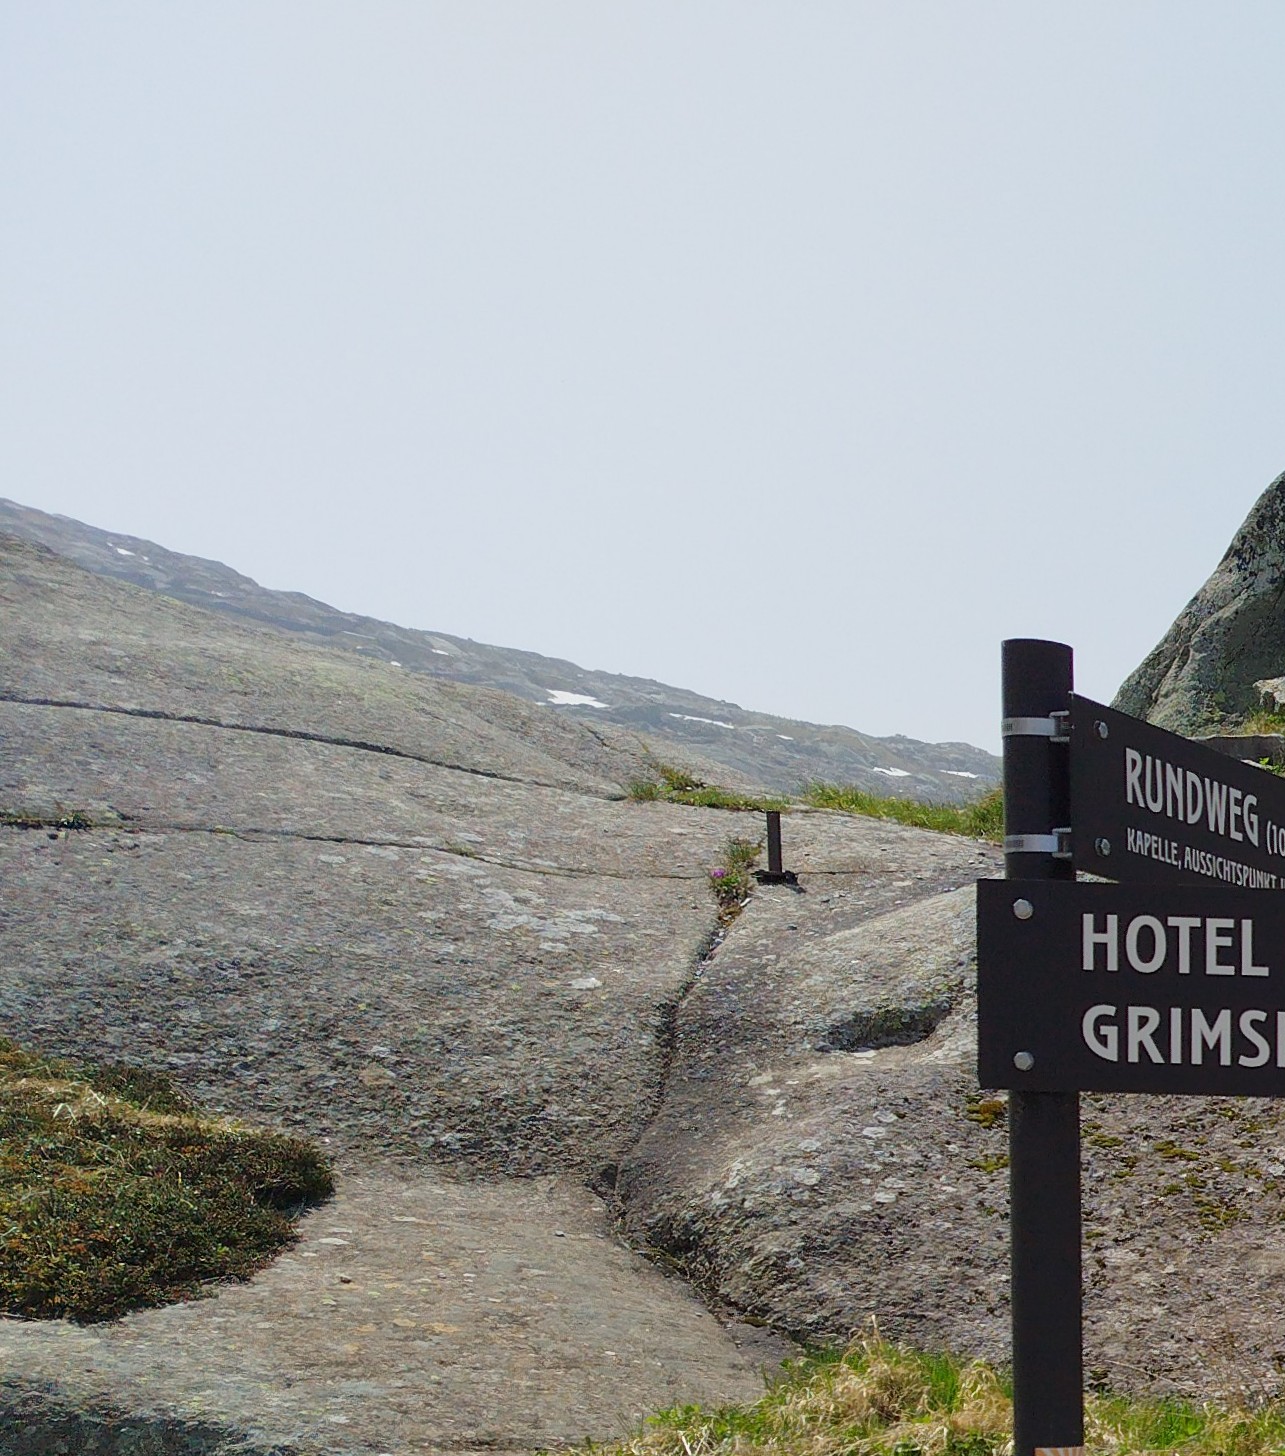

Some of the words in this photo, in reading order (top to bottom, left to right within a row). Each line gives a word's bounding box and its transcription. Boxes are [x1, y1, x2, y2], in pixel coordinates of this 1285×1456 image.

[1125, 747, 1259, 847] RUNDWEG
[1127, 827, 1182, 870] KAPELLE,
[1184, 846, 1277, 888] AUSSICHTSPUNKT
[1082, 913, 1270, 977] HOTEL
